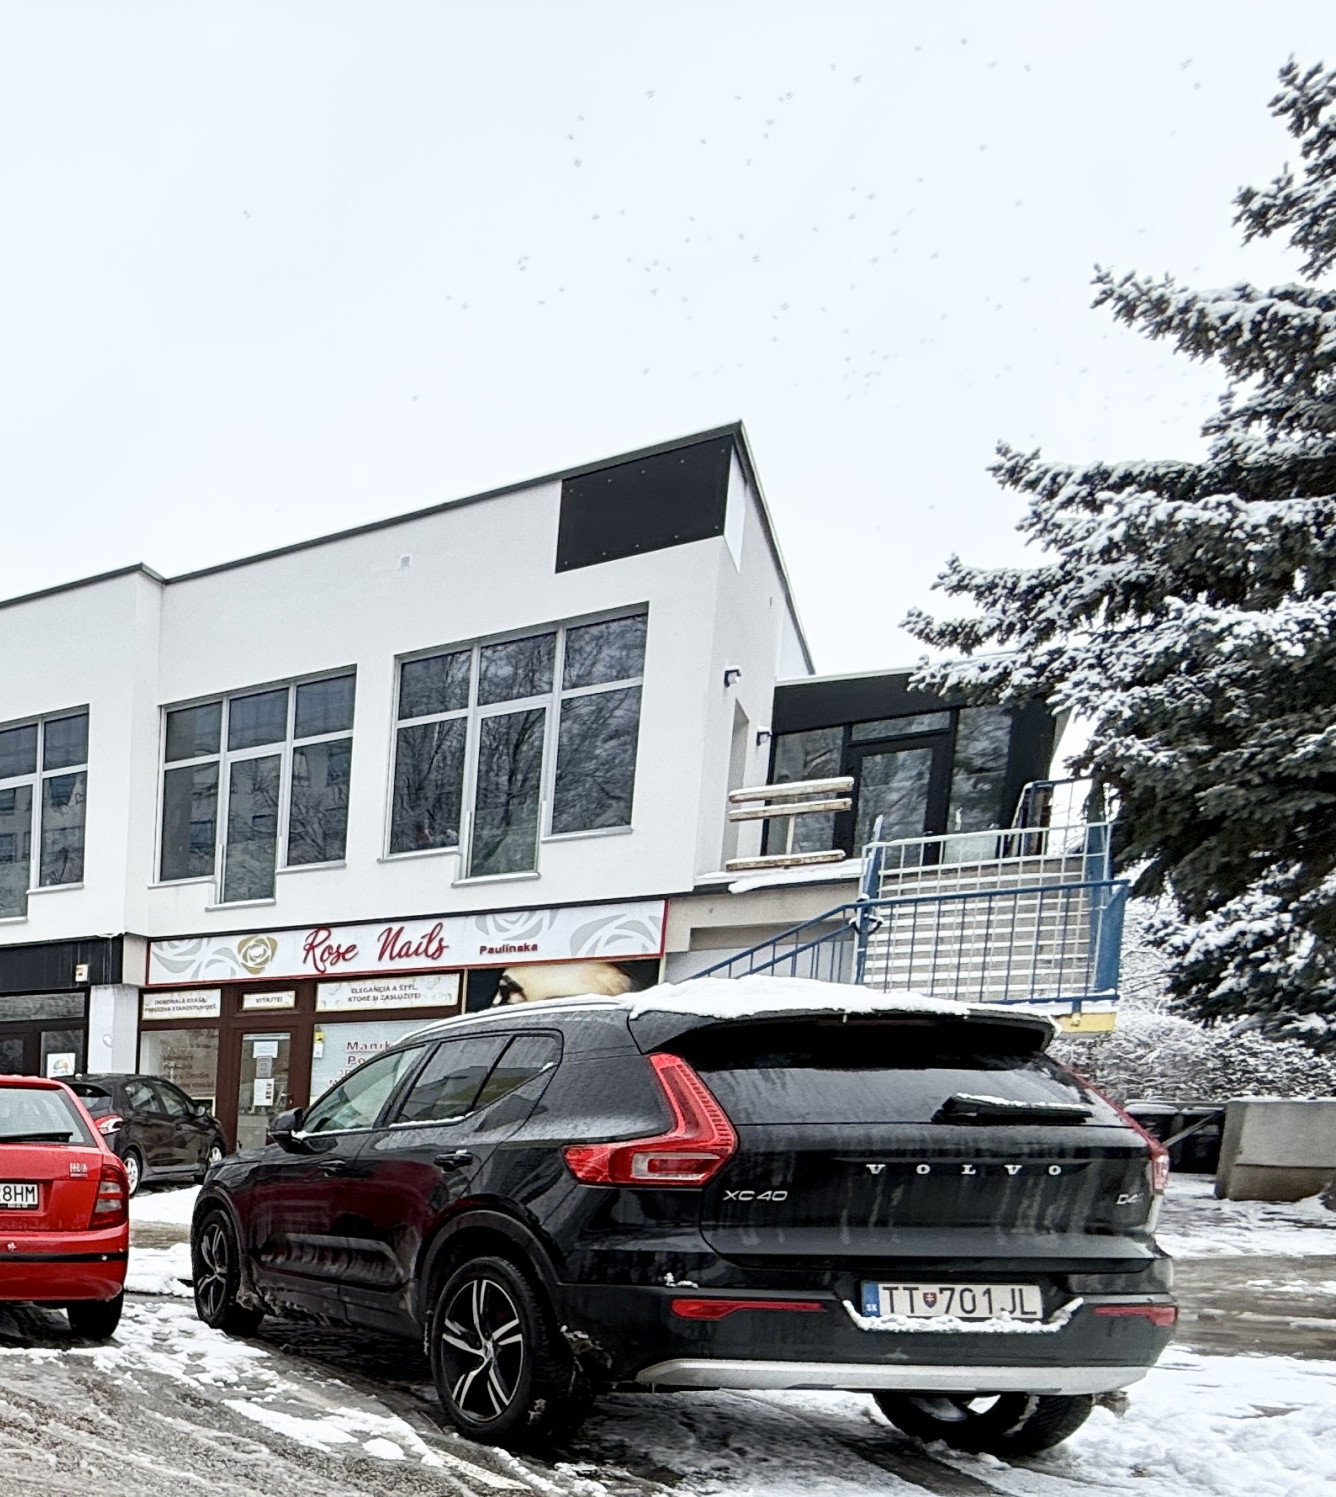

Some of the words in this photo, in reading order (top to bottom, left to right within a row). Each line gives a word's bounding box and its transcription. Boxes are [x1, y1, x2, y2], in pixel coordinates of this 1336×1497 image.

[302, 926, 359, 974] Rose
[377, 922, 450, 961] Nails
[346, 1040, 391, 1051] Manik
[866, 1164, 1062, 1176] VOLVO
